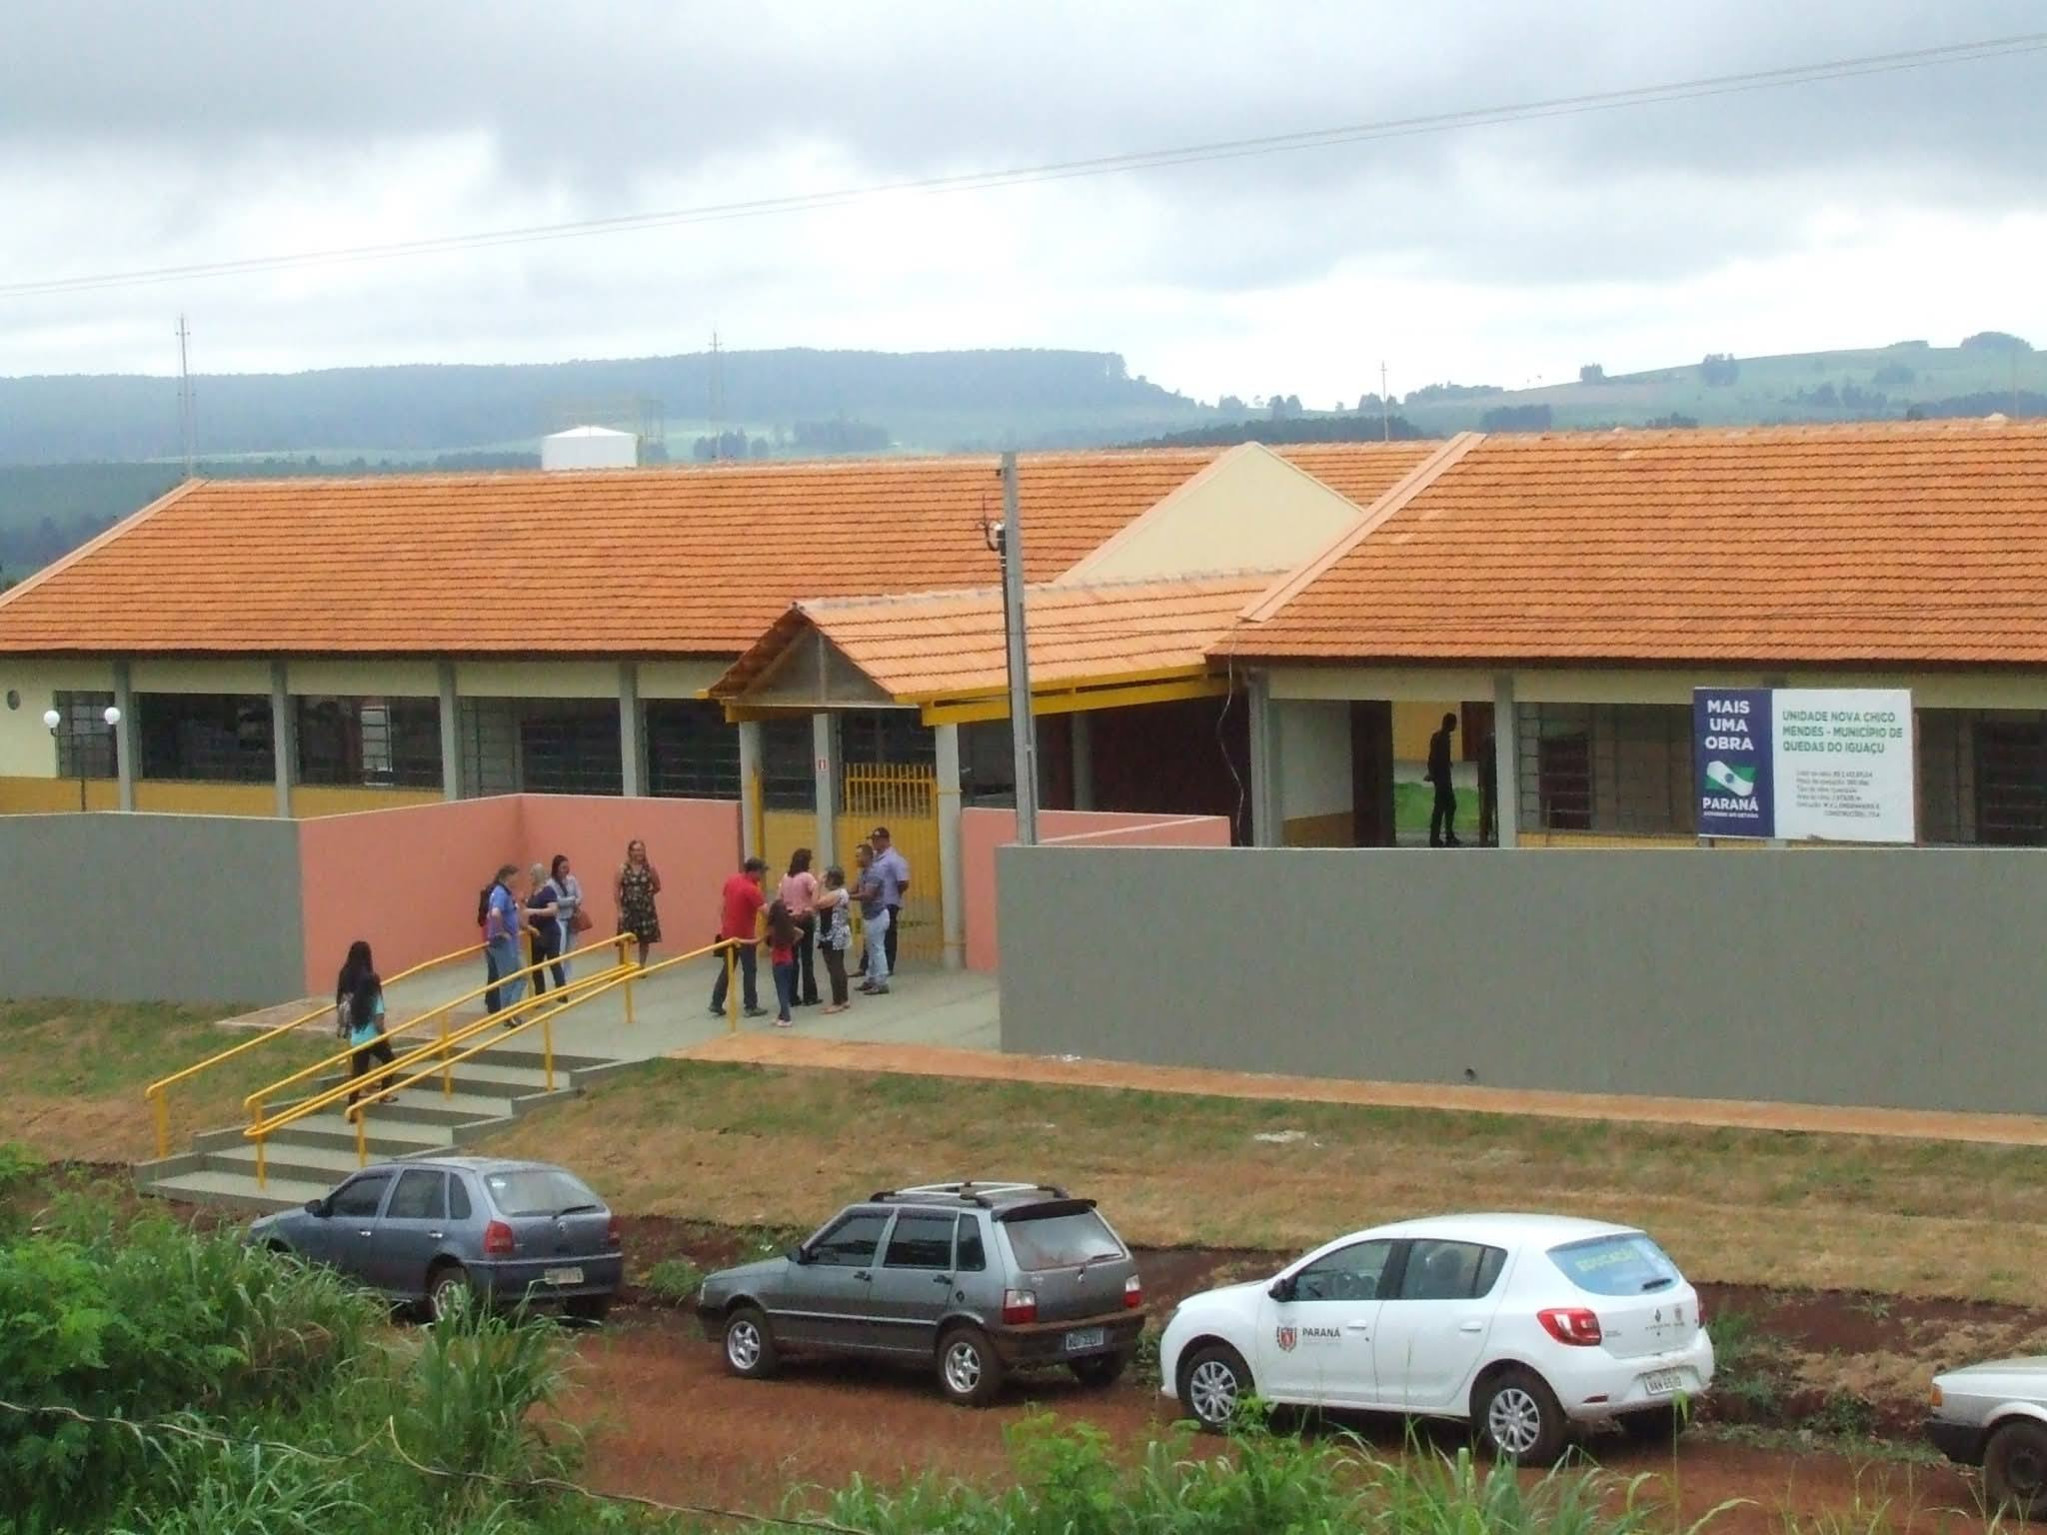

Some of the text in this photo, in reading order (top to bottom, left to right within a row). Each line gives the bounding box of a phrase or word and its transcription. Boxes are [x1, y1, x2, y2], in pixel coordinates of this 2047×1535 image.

[1707, 699, 1750, 714] MAIS
[1782, 710, 1896, 723] UNIDADE NOVA CHICO
[1709, 718, 1748, 732] UMA
[1782, 725, 1824, 737] MENDES
[1833, 724, 1887, 738] MUNICÍPIO
[1889, 727, 1903, 739] DE
[1704, 736, 1754, 751] OBRA
[1782, 740, 1885, 755] QUEDAS DO IGUAÇU
[1702, 796, 1759, 811] PARANÁ
[1302, 1327, 1341, 1338] PARANÁ
